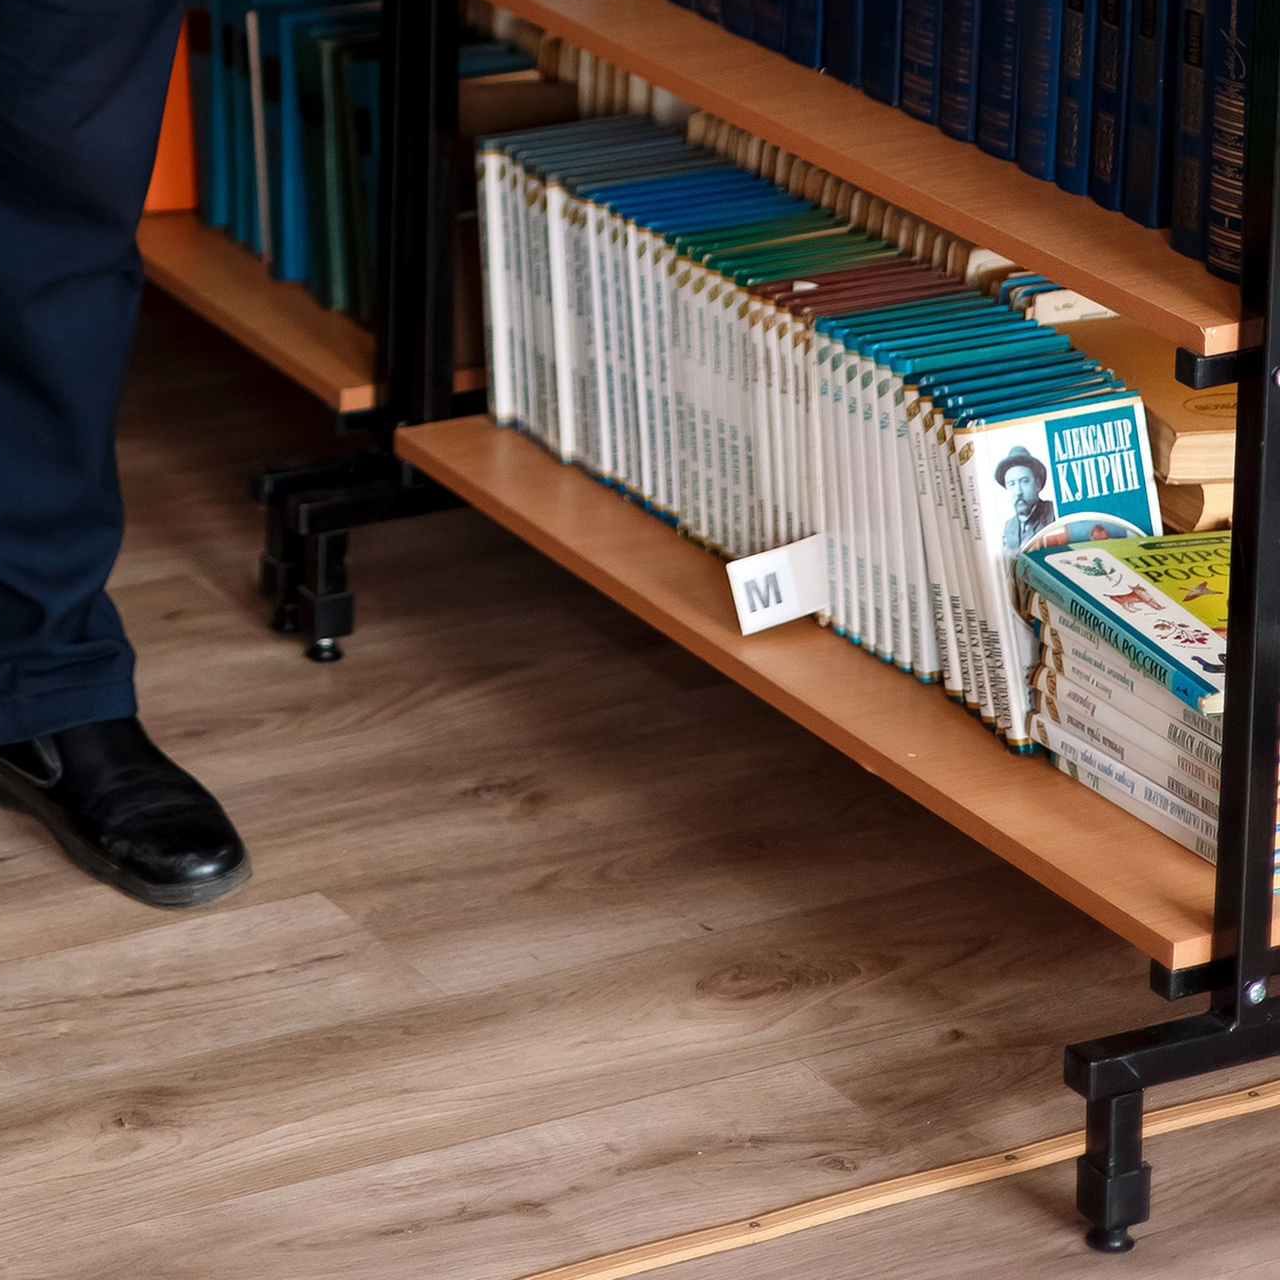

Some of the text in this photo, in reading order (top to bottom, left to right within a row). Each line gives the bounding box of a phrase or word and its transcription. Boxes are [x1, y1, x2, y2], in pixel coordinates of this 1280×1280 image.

[880, 412, 890, 430] Мы
[897, 420, 908, 438] Мы
[1054, 418, 1132, 462] АЛЕКСАНДР
[1056, 450, 1140, 504] КУПРИН
[1123, 548, 1231, 568] ПРИРО
[1138, 563, 1231, 584] РОСС
[744, 571, 782, 613] М
[950, 595, 964, 634] КУПРИН
[965, 608, 980, 648] КУПРИН
[990, 630, 1004, 670] КУПРИН
[1070, 598, 1169, 684] ПРИРОДА РОССИИ
[1167, 722, 1196, 753] КУПРИН
[1086, 771, 1100, 790] Мы
